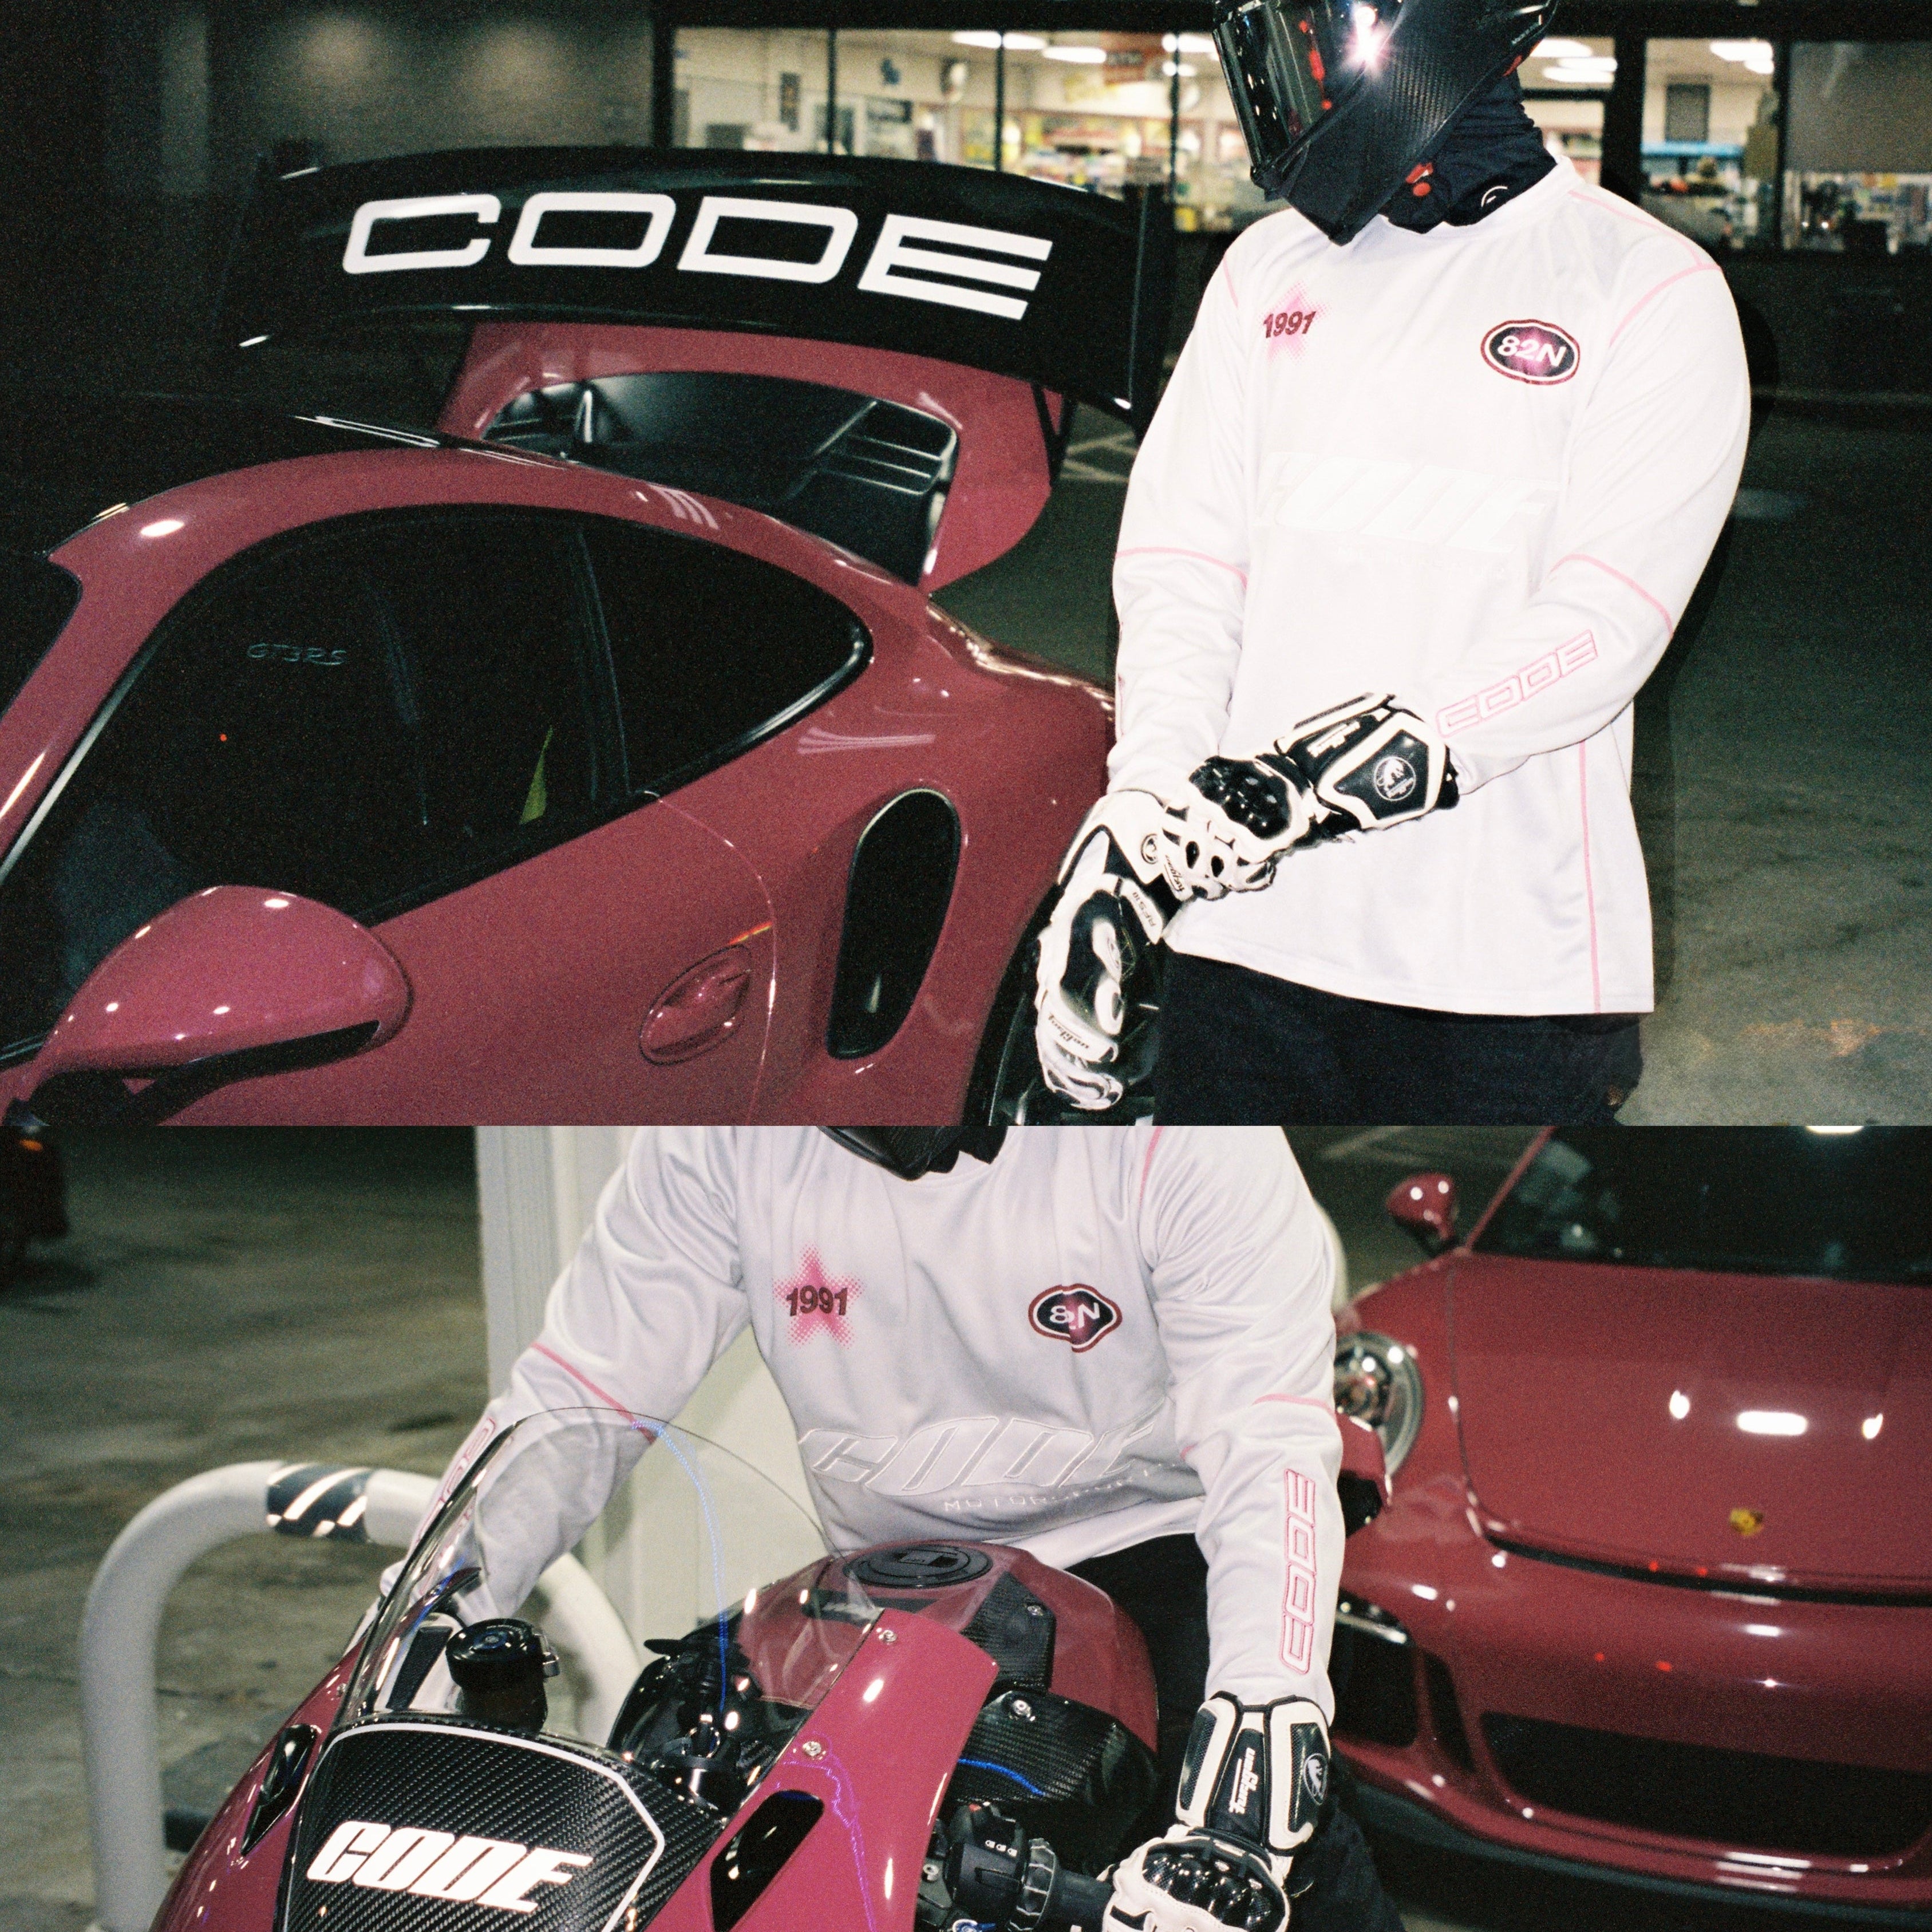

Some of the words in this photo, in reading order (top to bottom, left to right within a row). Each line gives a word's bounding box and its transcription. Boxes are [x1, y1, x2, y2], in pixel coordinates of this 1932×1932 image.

[343, 192, 1053, 320] CODE
[1263, 311, 1317, 338] 1991
[1498, 335, 1567, 366] 82N
[1436, 629, 1598, 738] CODE
[786, 1285, 847, 1316] 1991
[1279, 1468, 1317, 1675] CODE
[307, 1821, 593, 1913] CODE
